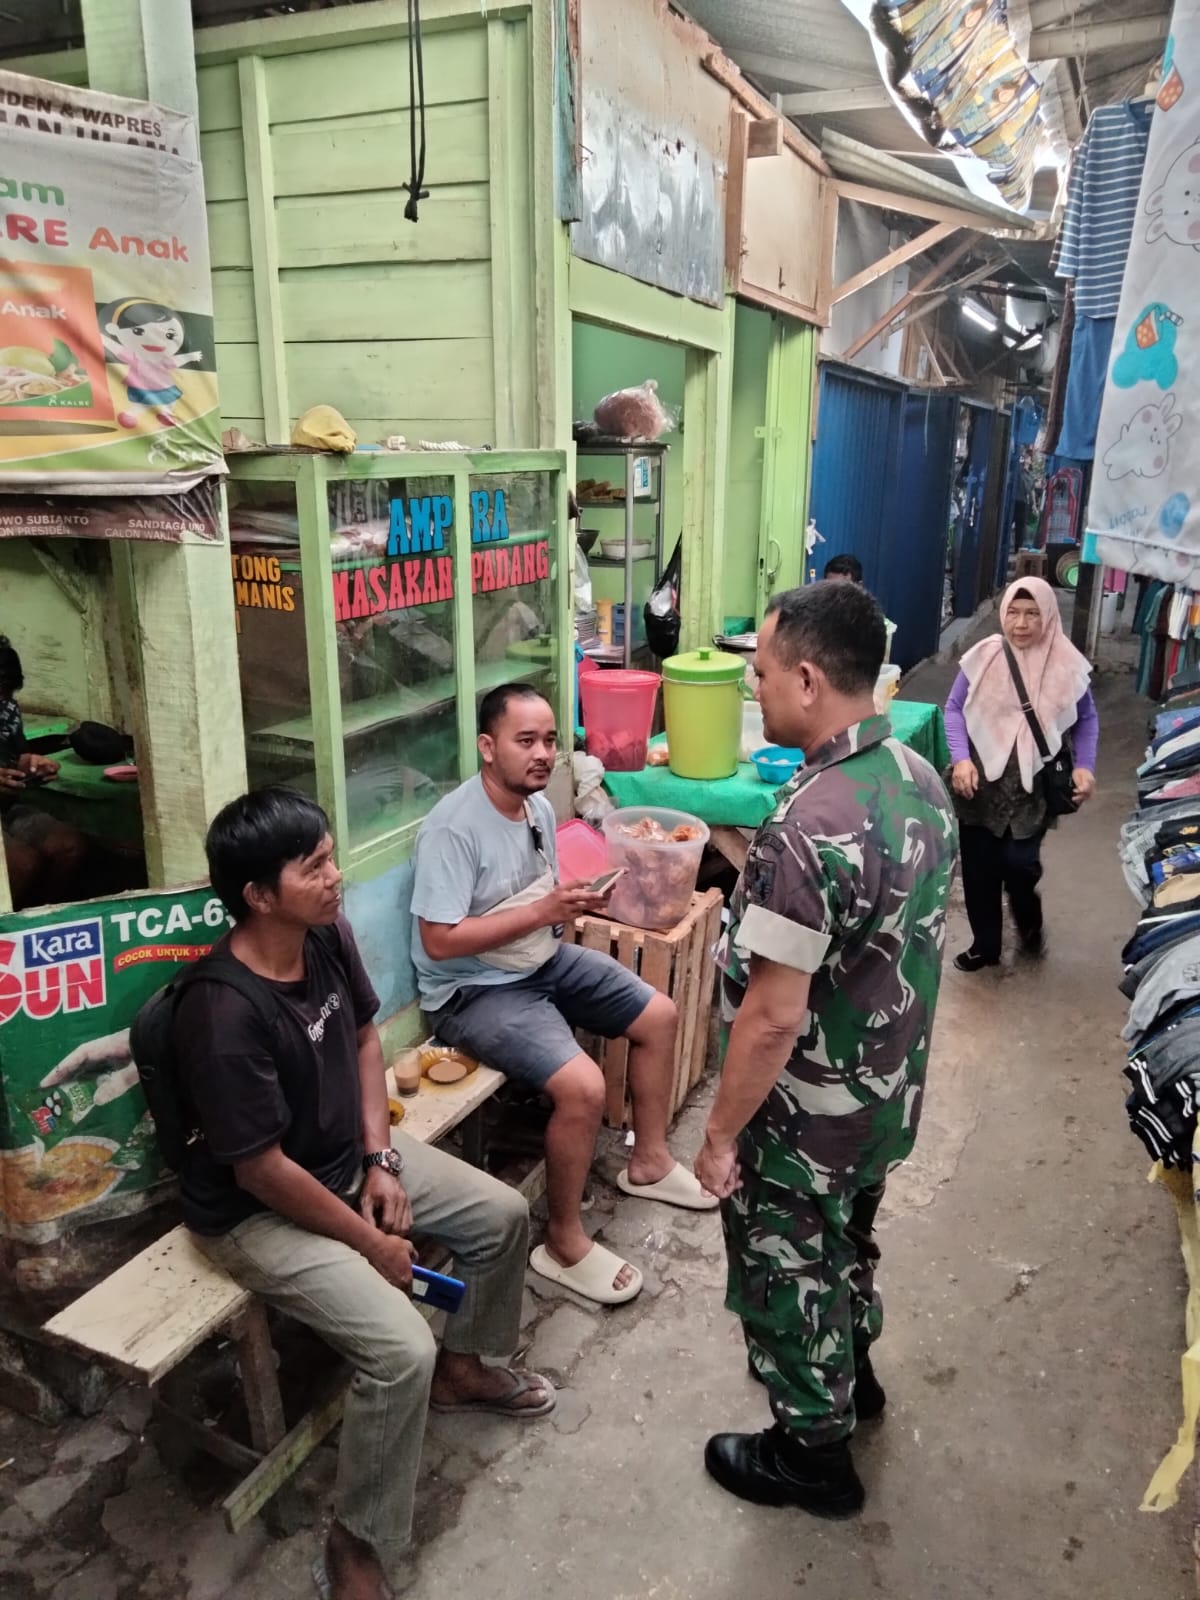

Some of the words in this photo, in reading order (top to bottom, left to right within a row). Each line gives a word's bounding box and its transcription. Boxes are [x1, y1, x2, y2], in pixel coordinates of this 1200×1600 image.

[60, 102, 74, 119] &
[82, 107, 162, 137] WAPRES
[0, 213, 69, 247] RE
[88, 226, 189, 262] Anak
[1, 300, 67, 320] Anak
[0, 515, 23, 526] WO
[26, 515, 89, 526] SUBIANTO
[17, 526, 72, 537] PRESIDEN
[104, 528, 141, 539] CALON
[128, 519, 186, 531] SANDIAGA
[188, 522, 206, 532] UNO
[231, 554, 281, 583] TONG
[331, 556, 454, 622] MASAKAN
[470, 540, 549, 595] PADANG
[235, 581, 296, 612] MANIS
[110, 897, 237, 943] TCA-6
[31, 930, 94, 962] kara
[118, 949, 153, 967] COCOK
[156, 948, 191, 957] UNTUK
